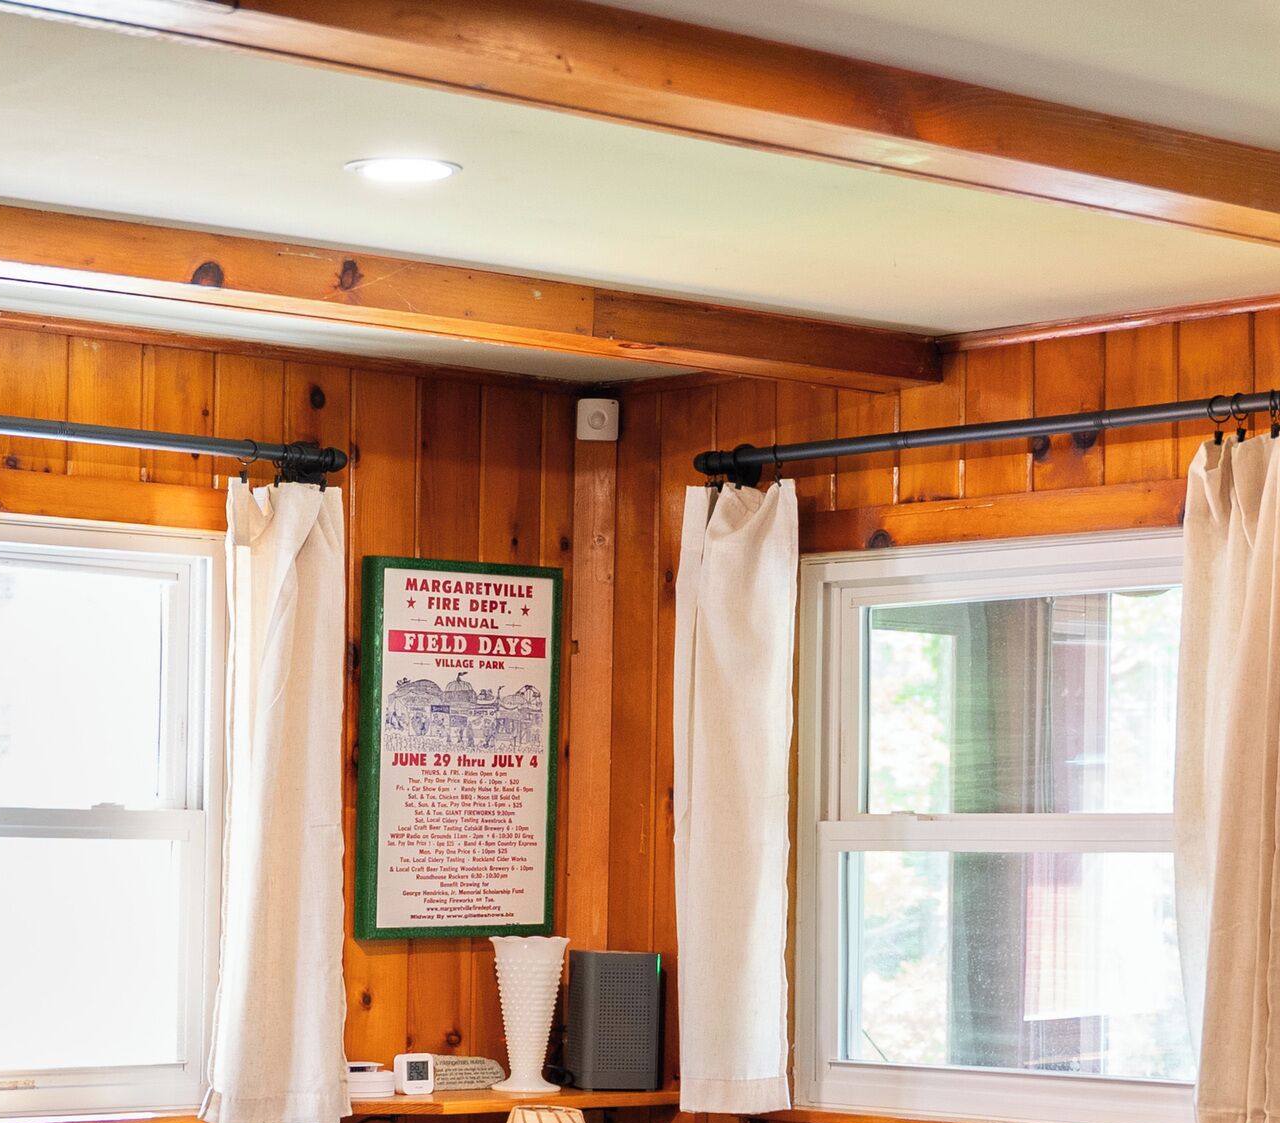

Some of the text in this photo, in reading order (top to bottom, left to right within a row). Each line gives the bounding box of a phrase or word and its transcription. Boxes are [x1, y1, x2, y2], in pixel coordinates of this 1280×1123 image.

[405, 578, 533, 598] MARGARETVILLE
[428, 597, 511, 614] FIRE DEPT.
[434, 616, 499, 629] ANNUAL
[404, 633, 532, 655] FIELD DAYS
[435, 659, 504, 669] VILLAGE PARK
[392, 753, 538, 768] JUNE 29 thru JULY 4
